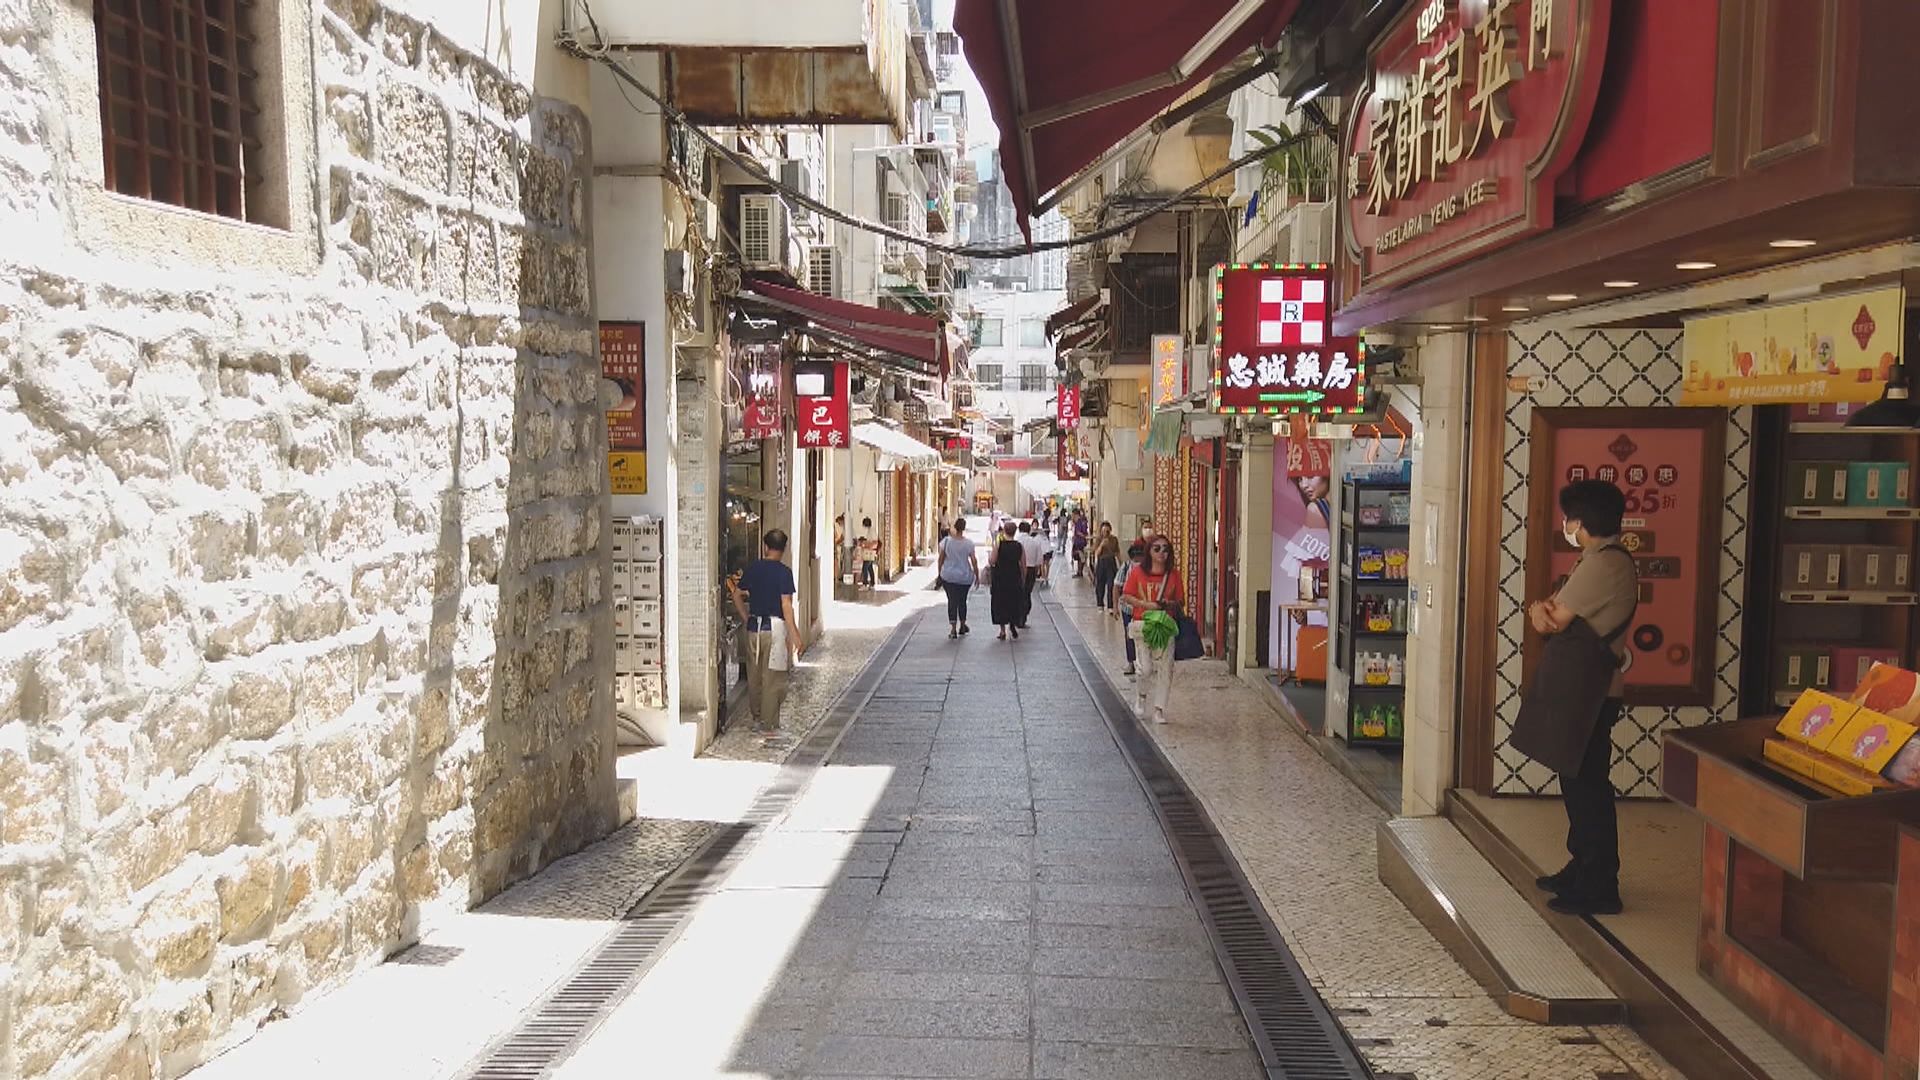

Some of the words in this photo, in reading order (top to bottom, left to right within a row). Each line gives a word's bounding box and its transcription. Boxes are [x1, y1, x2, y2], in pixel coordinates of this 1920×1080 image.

[1416, 0, 1445, 45] 1928
[1375, 215, 1423, 253] PASTELARIA
[1429, 196, 1457, 227] YENG
[1463, 179, 1485, 209] KEE
[1225, 352, 1357, 389] 忠誠藥房
[803, 428, 844, 445] 餅家
[1570, 466, 1674, 484] 月餅優惠
